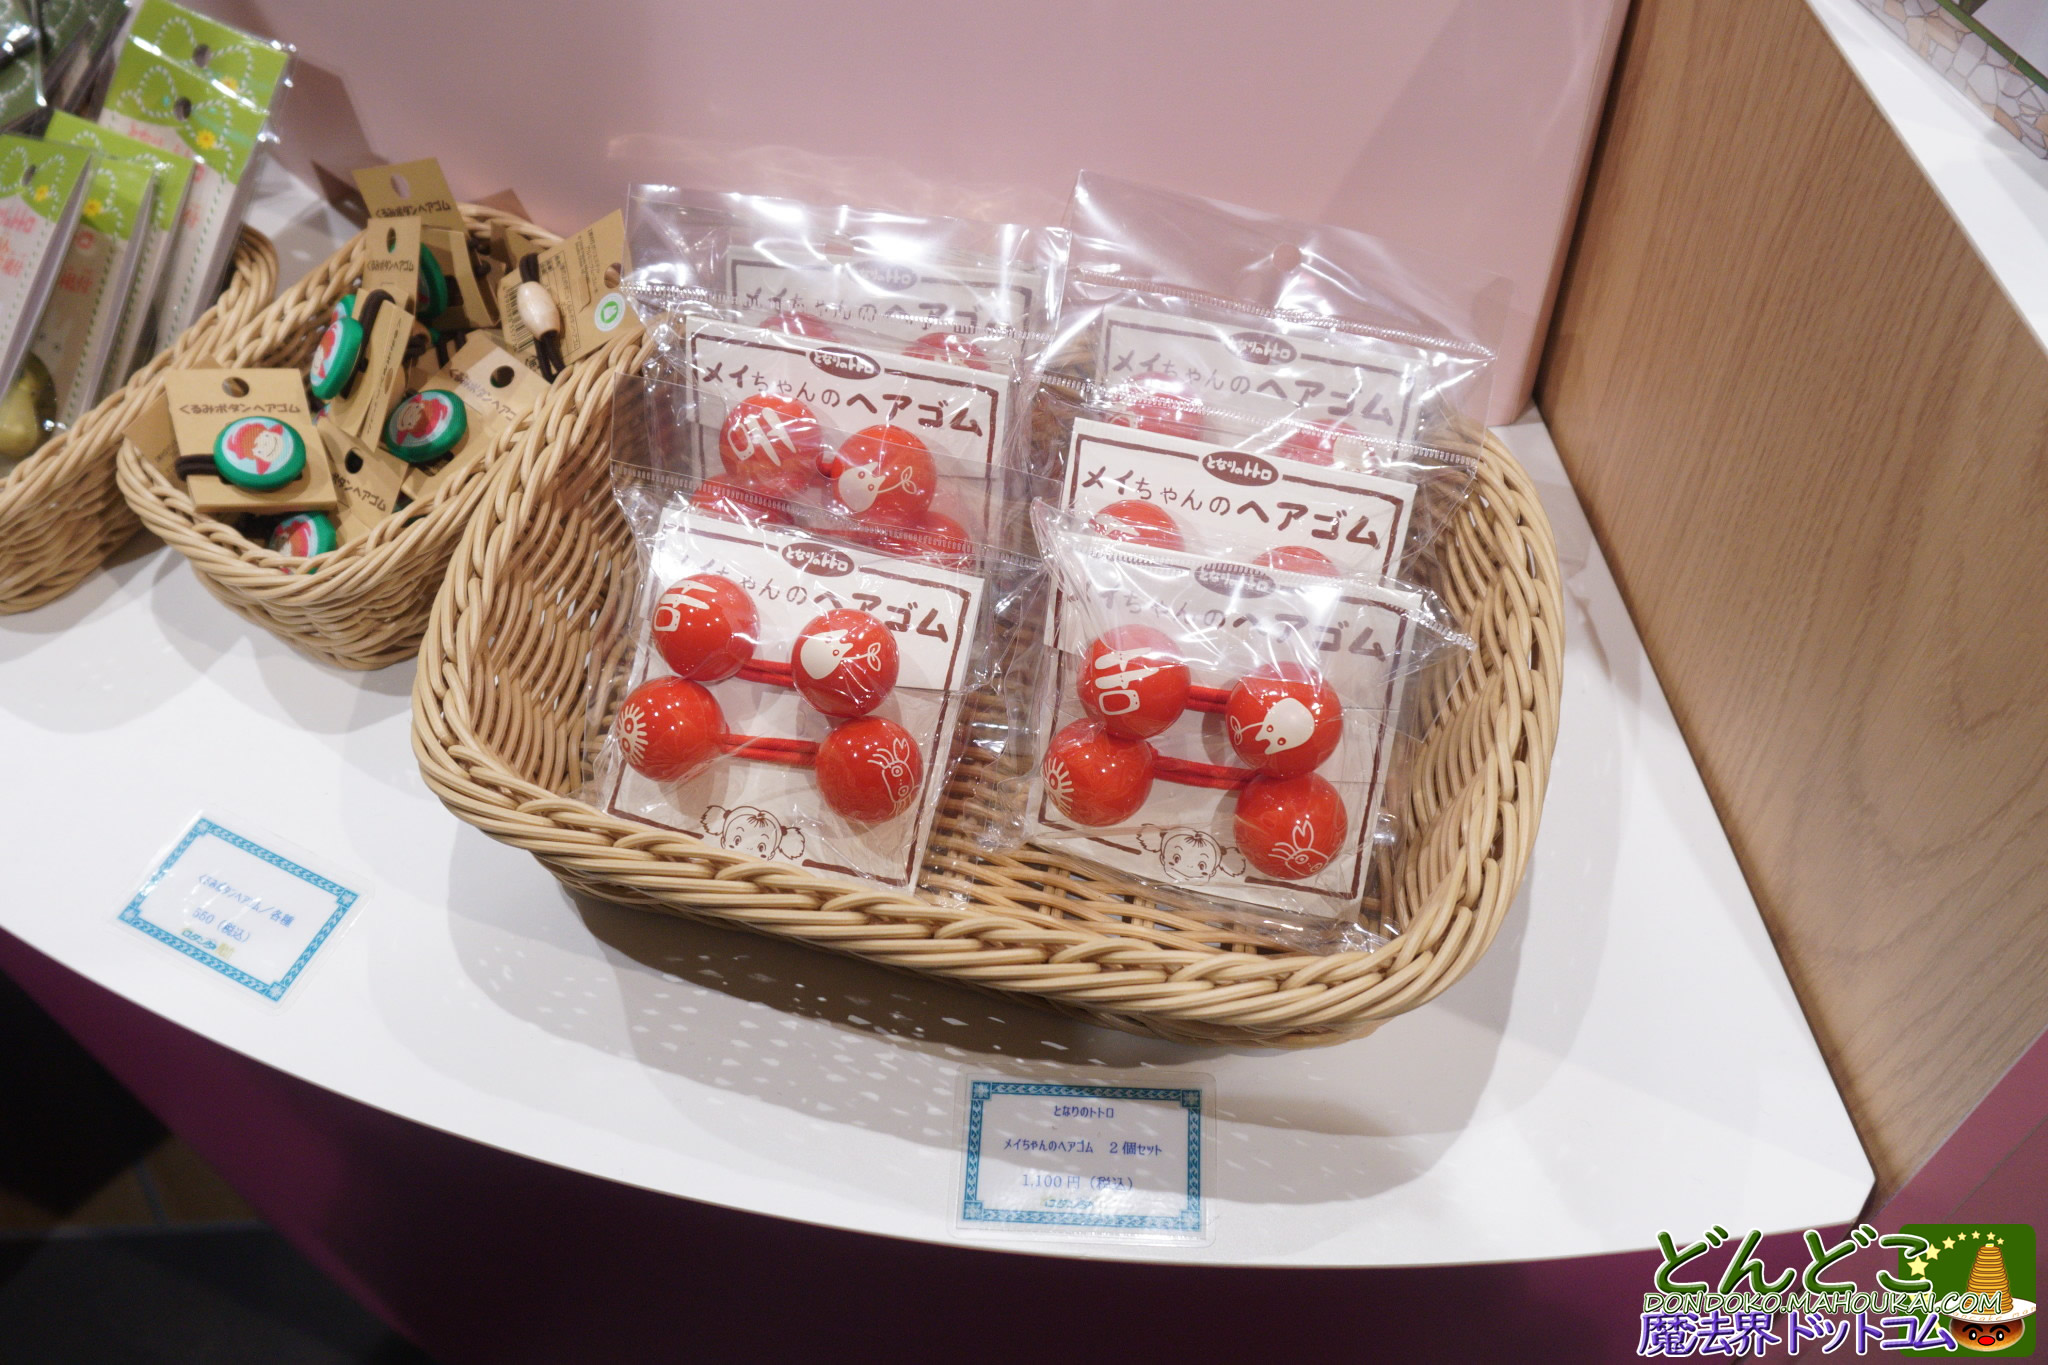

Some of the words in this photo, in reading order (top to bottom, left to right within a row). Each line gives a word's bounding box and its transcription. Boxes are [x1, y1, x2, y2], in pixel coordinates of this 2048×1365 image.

[813, 351, 875, 375] となりのトトロ
[449, 368, 518, 422] くるみボタンヘアゴ
[702, 361, 984, 438] メイちゃんのヘアゴム
[1112, 350, 1394, 426] メイちゃんのヘアゴム
[179, 403, 301, 415] くるみボタンヘアゴム
[1206, 455, 1272, 481] となりのトトロ
[1082, 466, 1381, 549] メイちゃんのヘアゴム
[785, 546, 849, 572] となりのトトロ
[1053, 1105, 1115, 1119] となりのトトロ
[1004, 1138, 1094, 1154] メイちゃんのヘアゴム
